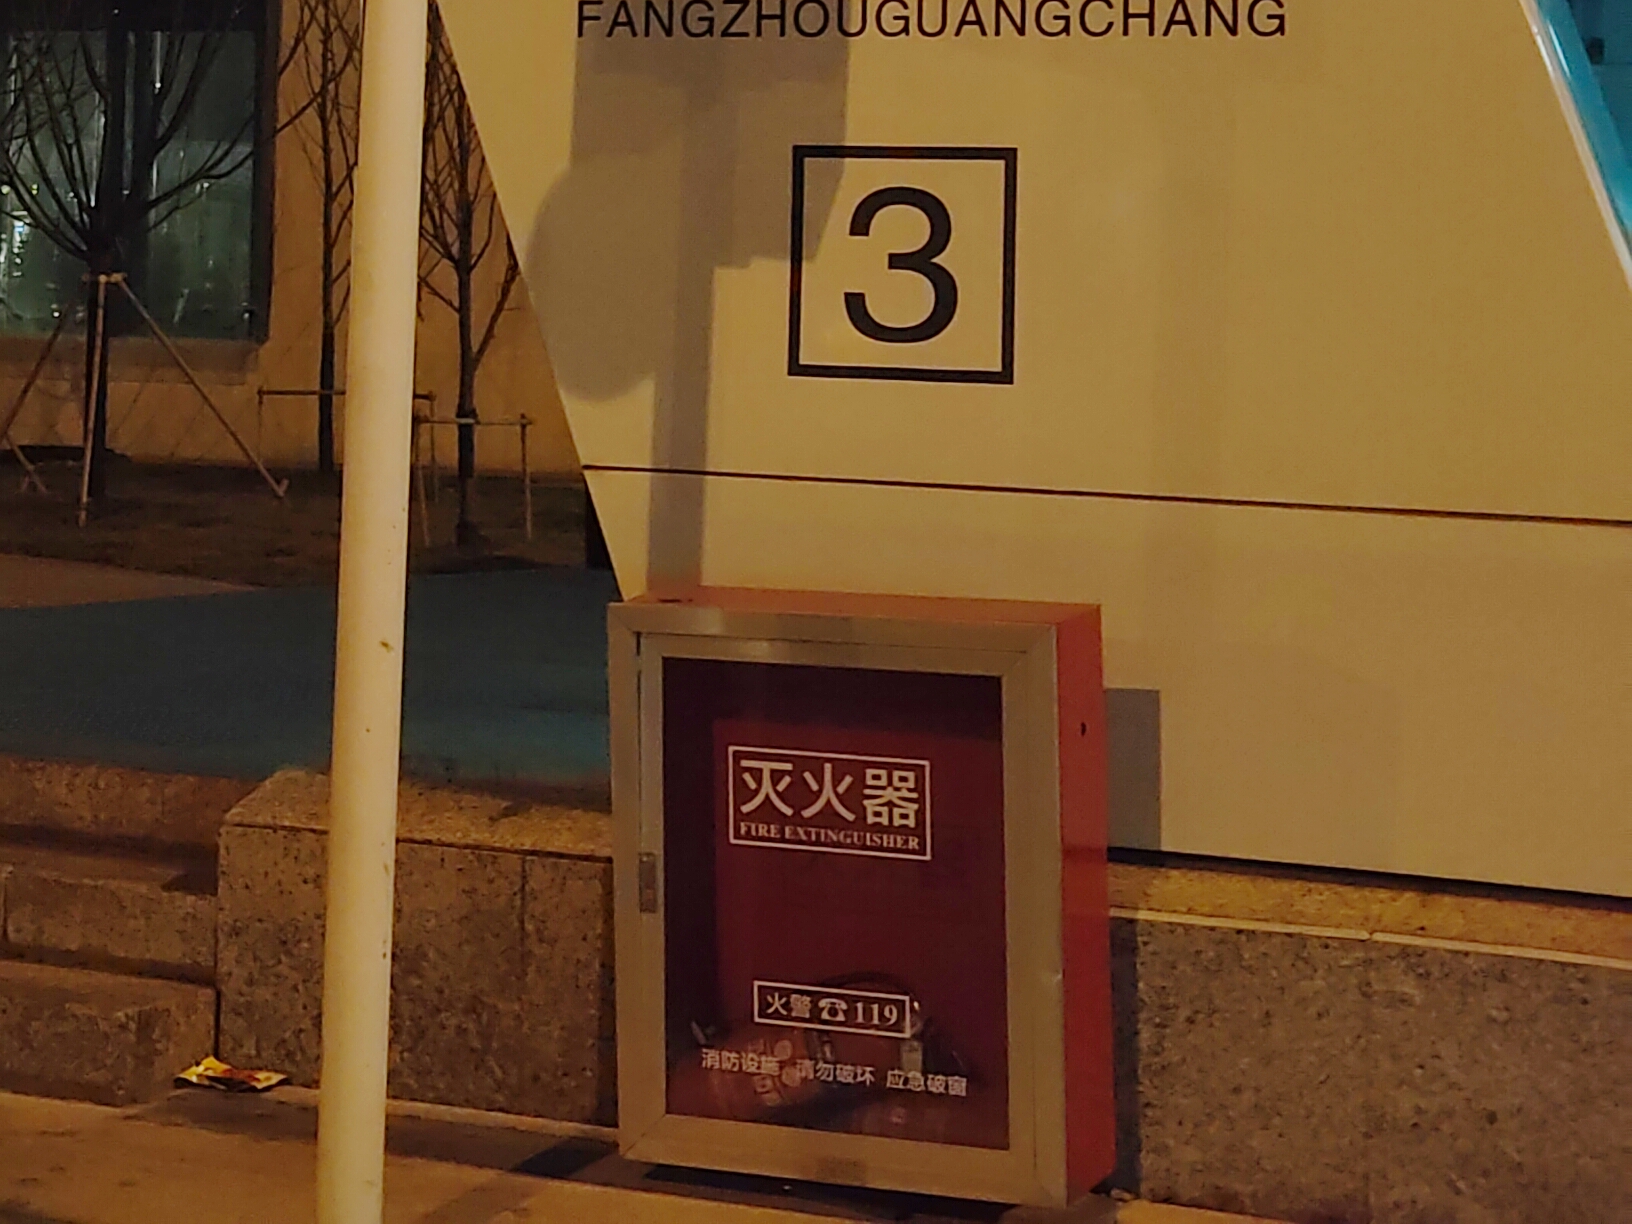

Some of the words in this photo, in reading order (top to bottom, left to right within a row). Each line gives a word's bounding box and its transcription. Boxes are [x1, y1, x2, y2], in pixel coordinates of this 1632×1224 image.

[843, 185, 960, 344] 3
[739, 759, 920, 829] 灭火器
[739, 821, 781, 839] FIRE
[784, 825, 920, 850] EXTINGUISHER
[765, 991, 813, 1019] 火警
[854, 1001, 899, 1026] 119
[701, 1047, 782, 1076] 消防设施
[795, 1058, 876, 1086] 请勿破坏
[886, 1069, 968, 1097] 应急破窗
